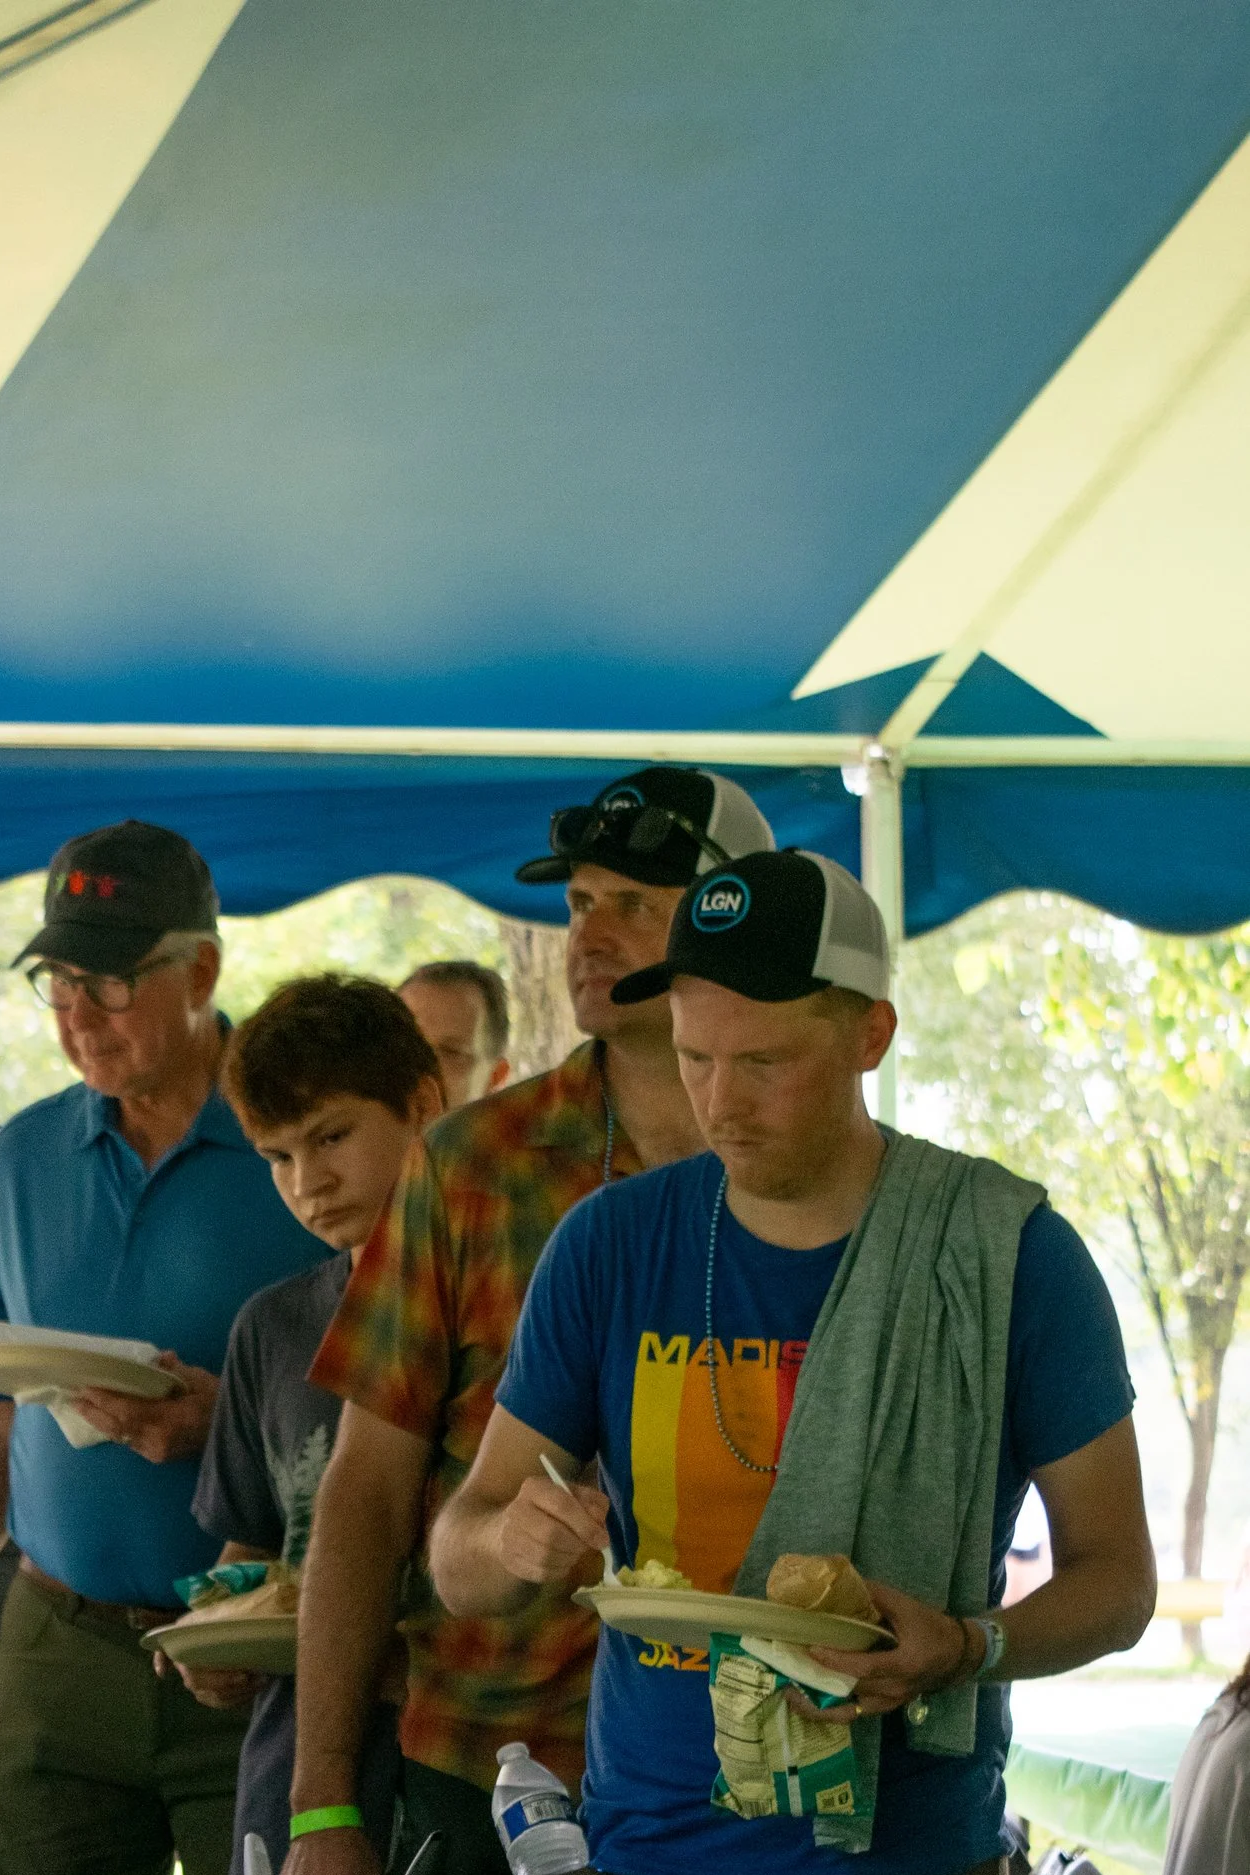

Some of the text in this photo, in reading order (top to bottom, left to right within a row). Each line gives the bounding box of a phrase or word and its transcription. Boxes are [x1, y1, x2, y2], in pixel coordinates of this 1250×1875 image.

[701, 890, 742, 912] LGN
[639, 1331, 810, 1370] MADIS
[638, 1637, 709, 1672] JAZ
